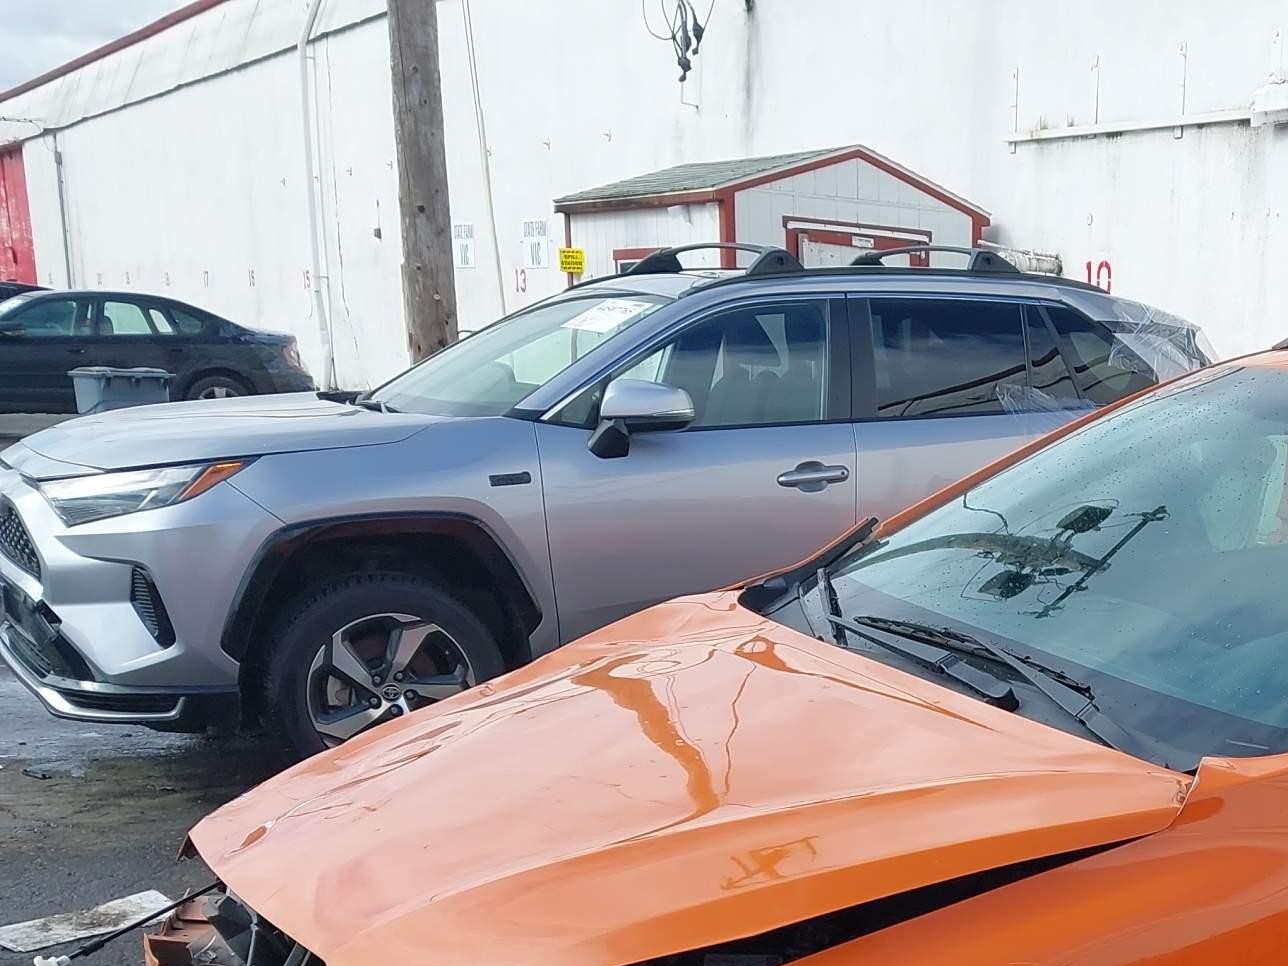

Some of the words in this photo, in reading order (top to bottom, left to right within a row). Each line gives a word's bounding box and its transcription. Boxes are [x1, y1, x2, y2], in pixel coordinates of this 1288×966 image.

[530, 242, 541, 266] VIC
[303, 269, 311, 289] 15
[515, 268, 527, 293] 13
[1086, 260, 1111, 294] 10
